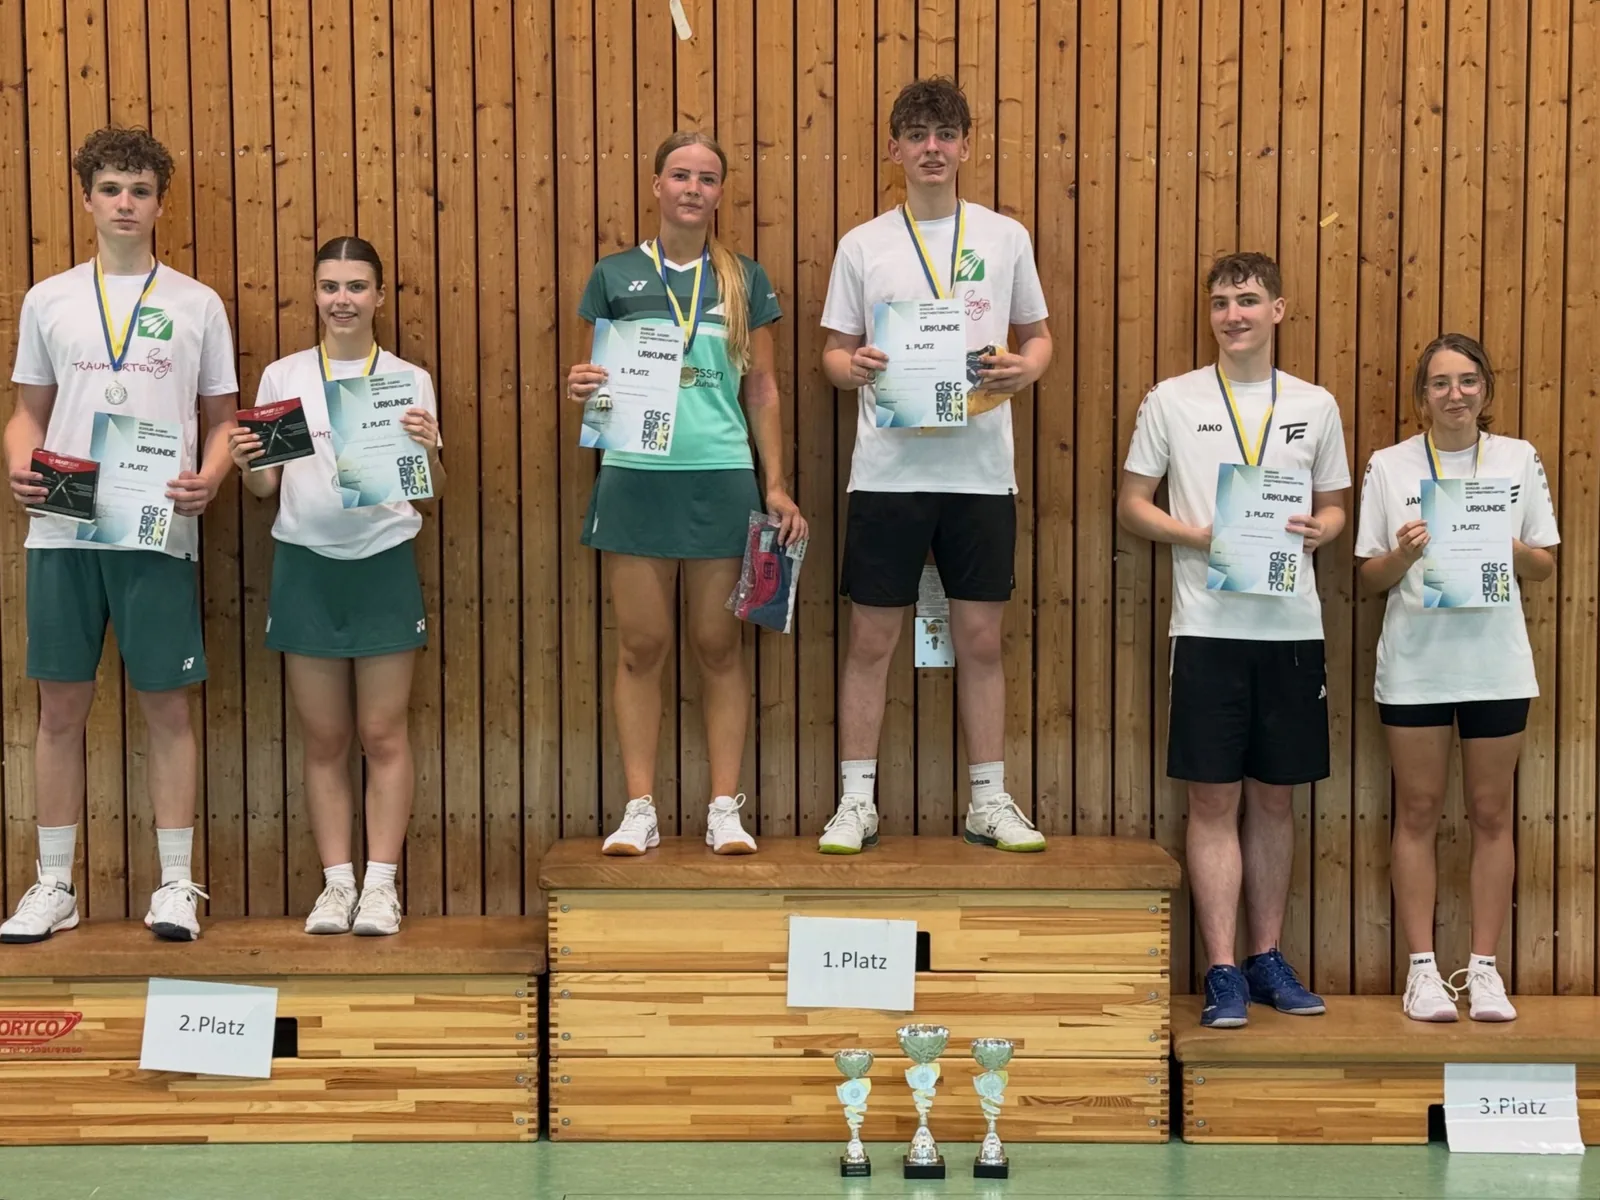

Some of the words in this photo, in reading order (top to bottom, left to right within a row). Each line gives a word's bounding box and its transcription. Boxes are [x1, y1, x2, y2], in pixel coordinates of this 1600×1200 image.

[920, 324, 960, 332] URKUNDE
[638, 350, 678, 361] URKUNDE
[72, 361, 154, 373] TRAUMRTEN
[629, 368, 649, 376] PLATZ
[374, 397, 414, 409] URKUNDE
[370, 420, 391, 428] PLATZ
[1197, 424, 1222, 432] JAKO
[136, 445, 176, 458] URKUNDE
[128, 463, 149, 472] PLATZ
[1262, 493, 1302, 503] URKUNDE
[1466, 504, 1506, 512] URKUNDE
[1254, 511, 1274, 519] PLATZ
[823, 952, 888, 970] 1.Platz
[179, 1015, 245, 1036] 2.Platz
[1480, 1097, 1547, 1114] 3.Platz
